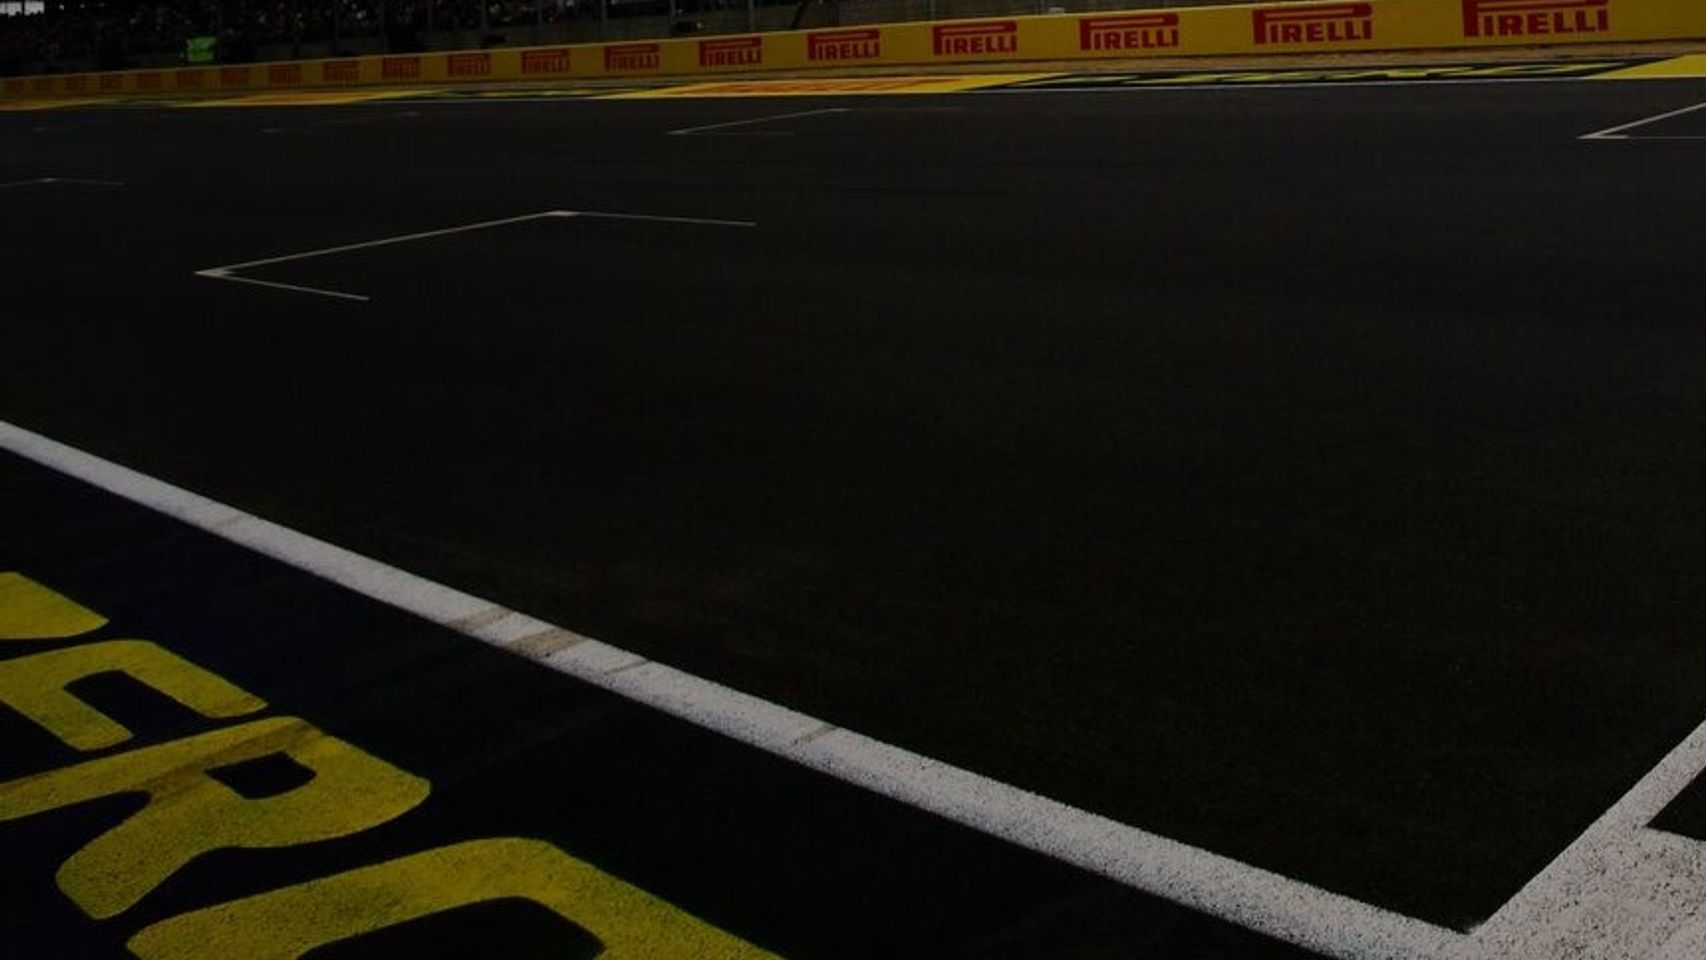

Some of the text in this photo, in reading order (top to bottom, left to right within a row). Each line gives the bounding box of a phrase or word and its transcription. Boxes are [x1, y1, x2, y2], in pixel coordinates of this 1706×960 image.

[932, 21, 1018, 56] PIRELLI
[1079, 13, 1179, 51] PIRELLI
[1252, 3, 1373, 44] PIRELLI
[699, 38, 762, 66] PIRELLI
[807, 29, 880, 60] PIRELLI
